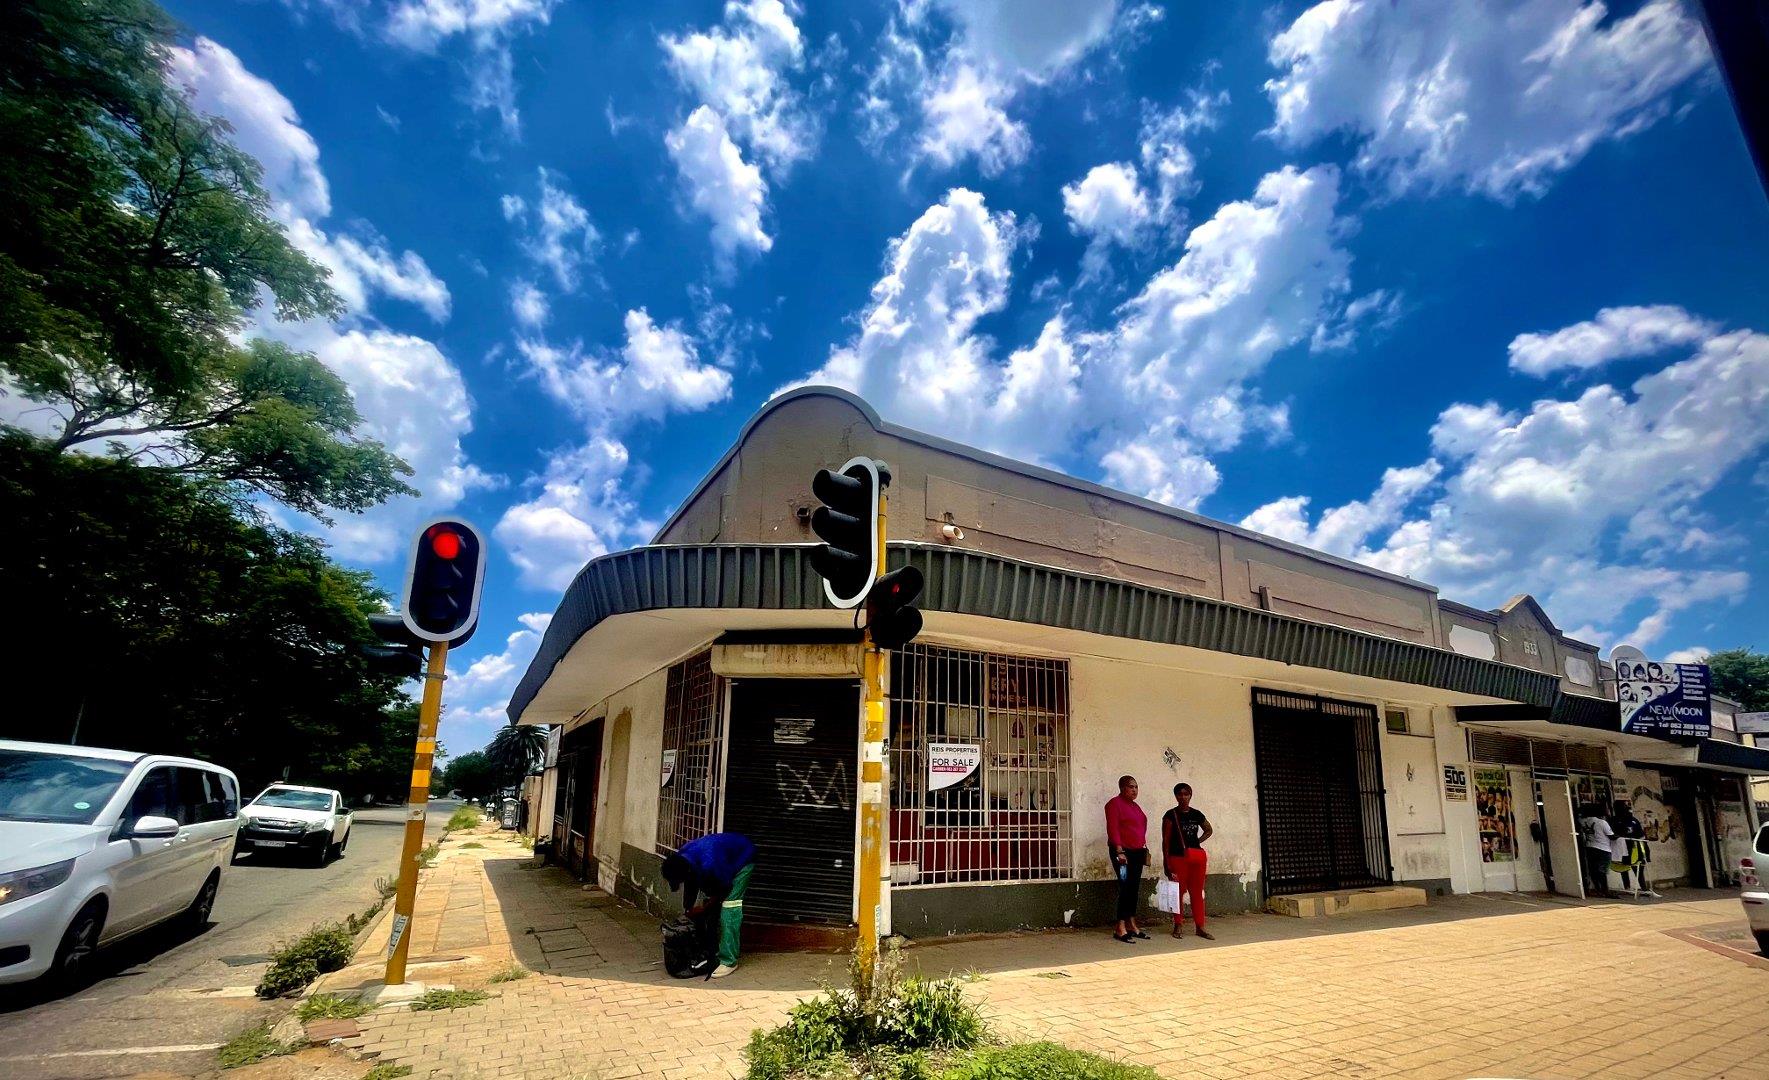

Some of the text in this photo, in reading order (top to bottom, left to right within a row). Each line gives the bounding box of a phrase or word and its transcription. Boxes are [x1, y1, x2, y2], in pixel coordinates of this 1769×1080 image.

[1649, 705, 1703, 716] NEW MOON
[932, 758, 974, 767] FOR SALE
